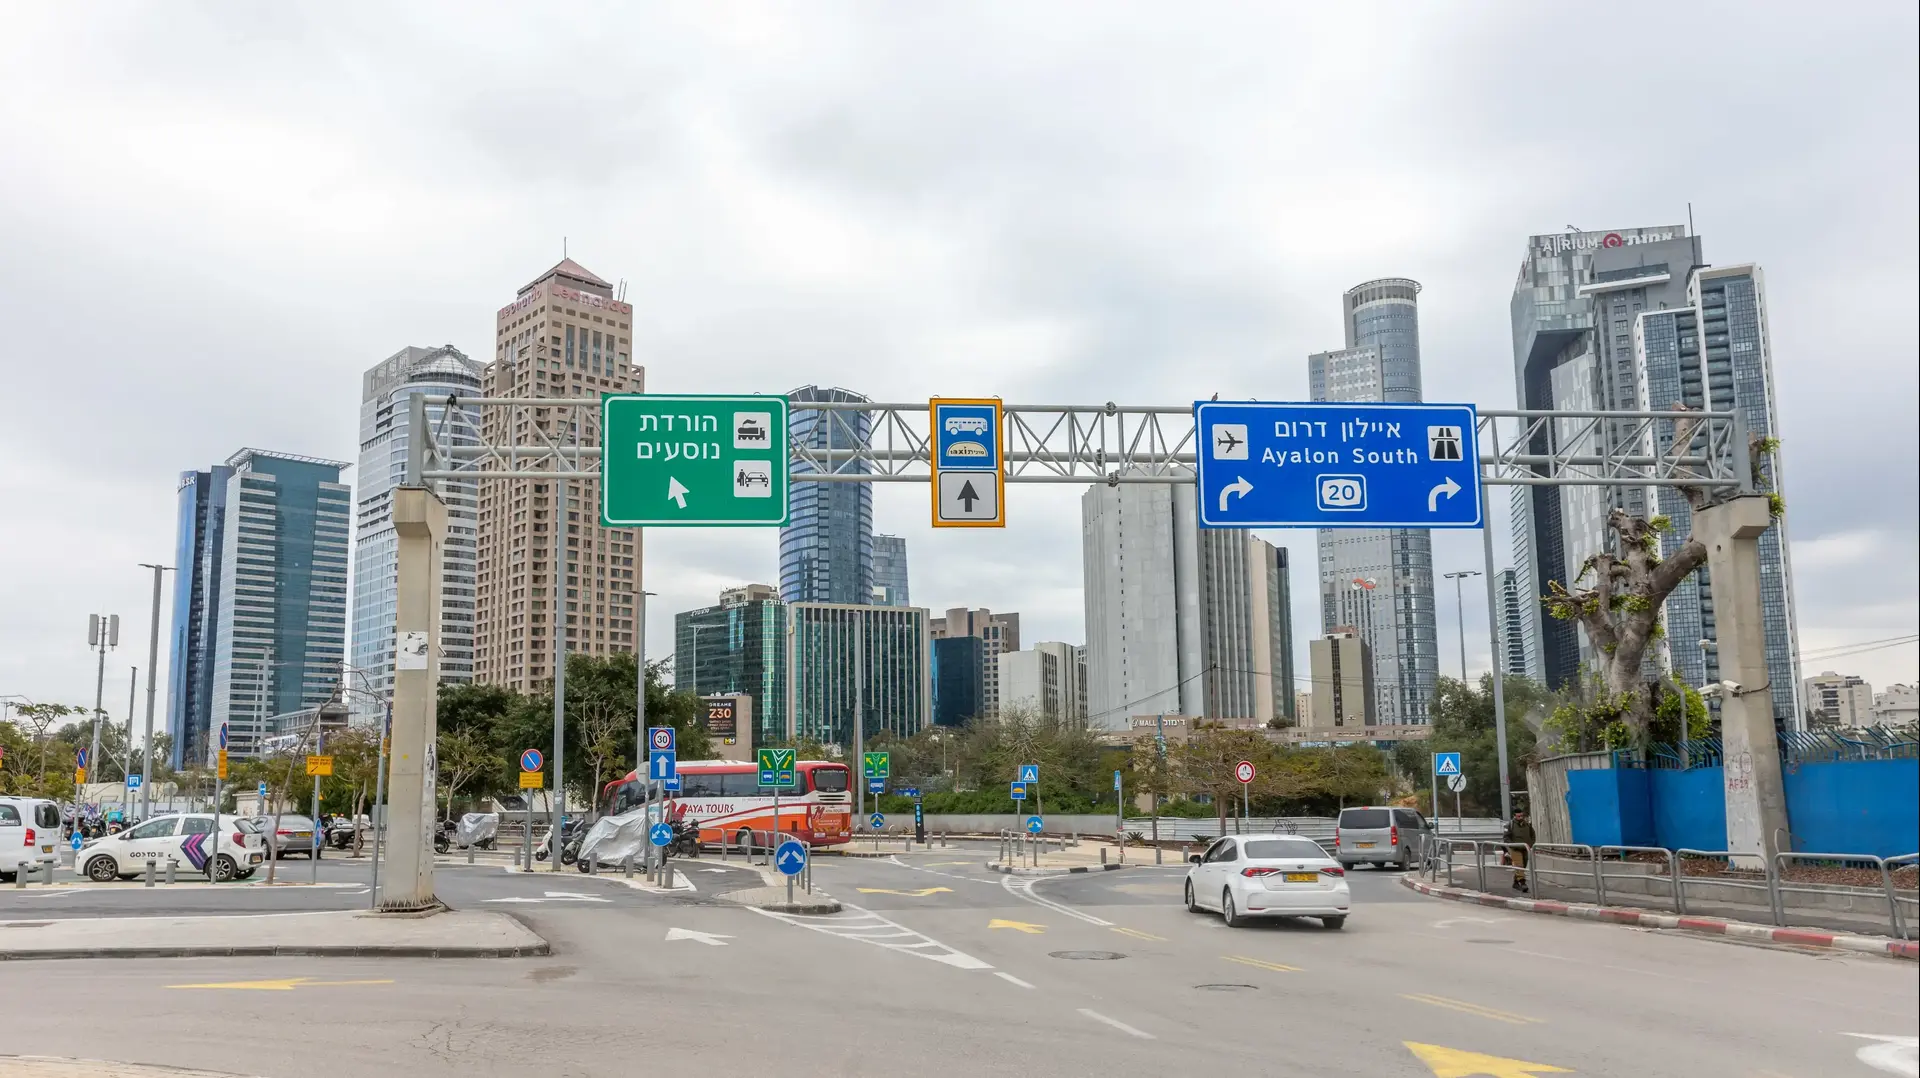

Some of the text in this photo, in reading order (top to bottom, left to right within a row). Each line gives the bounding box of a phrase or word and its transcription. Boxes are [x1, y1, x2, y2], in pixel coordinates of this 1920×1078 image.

[552, 284, 630, 315] Leonardo
[639, 414, 718, 432] הורדת
[1274, 417, 1401, 442] איילון דרום
[636, 442, 720, 461] נוסעים
[1261, 447, 1418, 467] Ayalon South
[1328, 484, 1355, 500] 20
[709, 708, 732, 719] Z30
[656, 735, 668, 744] 30
[706, 804, 734, 814] TOURS
